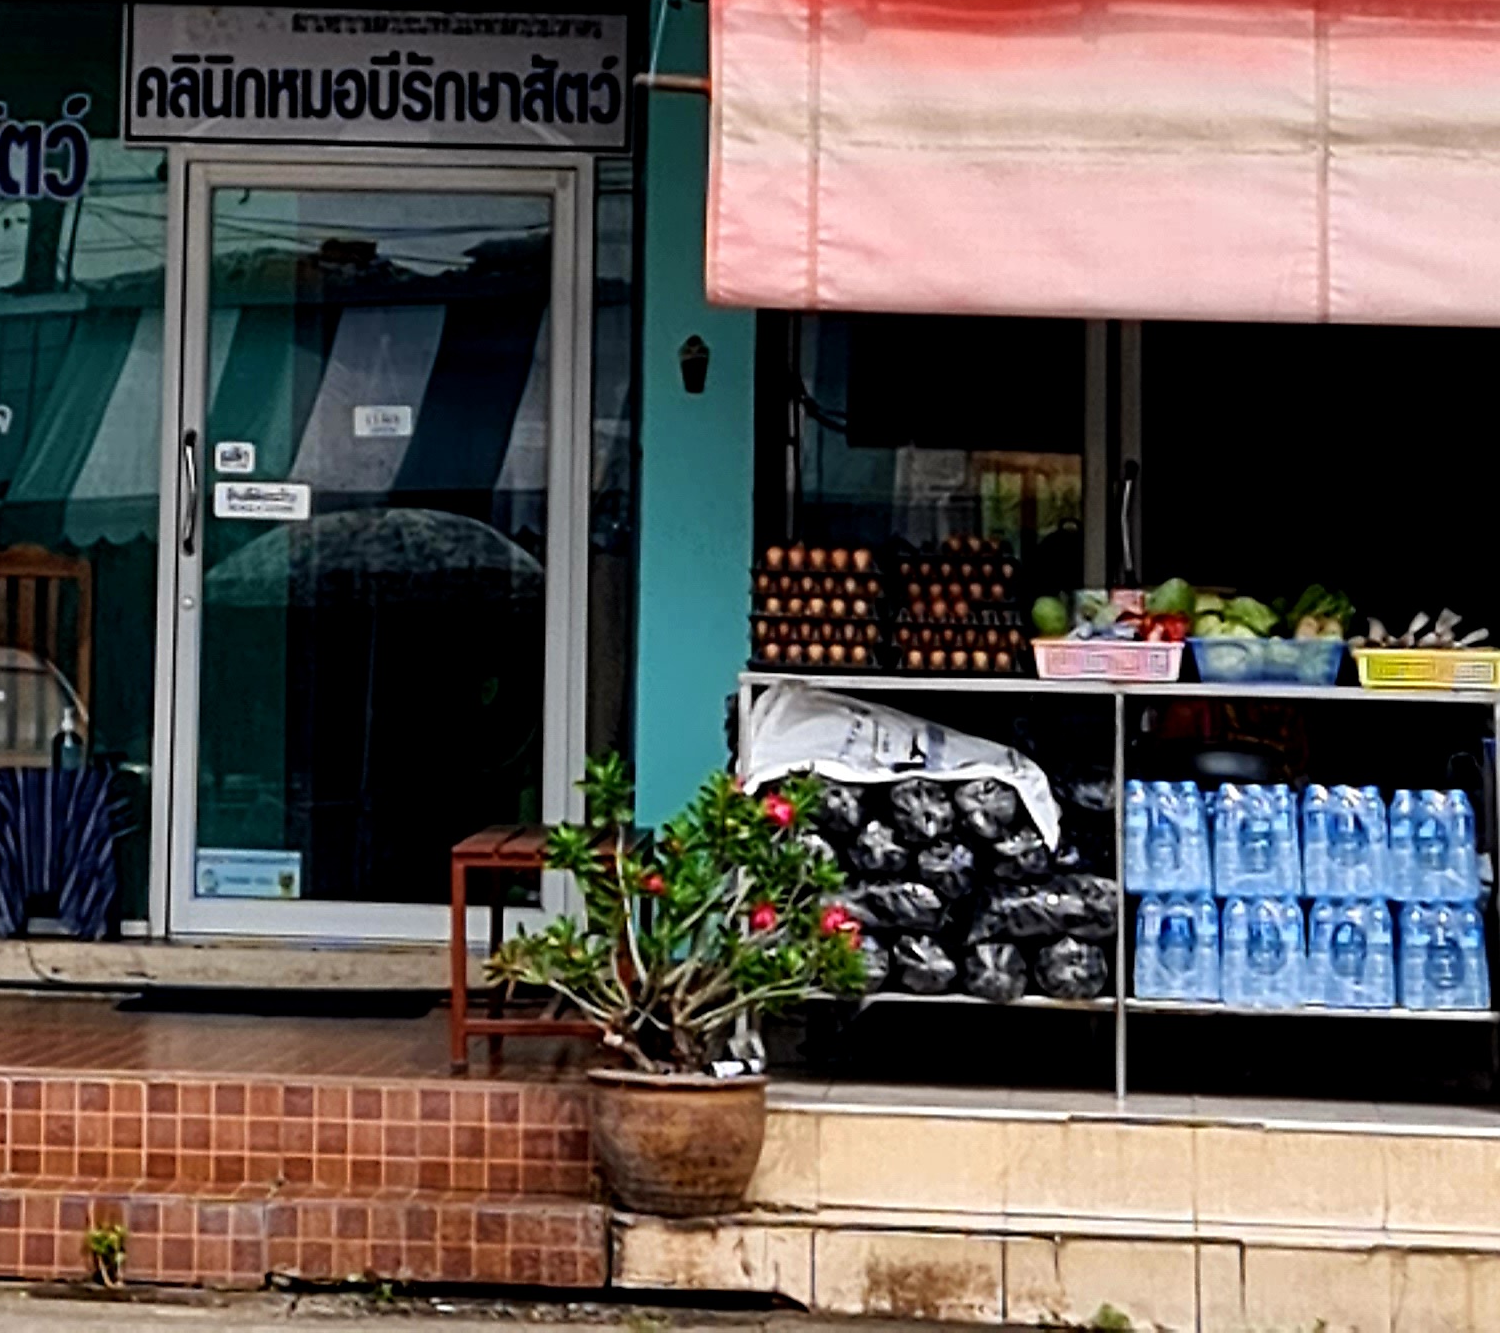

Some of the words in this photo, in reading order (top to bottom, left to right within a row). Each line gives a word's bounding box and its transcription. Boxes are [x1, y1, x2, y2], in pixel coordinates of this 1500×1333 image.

[135, 50, 622, 127] คลินิกหมอบีรักษาสัตว์
